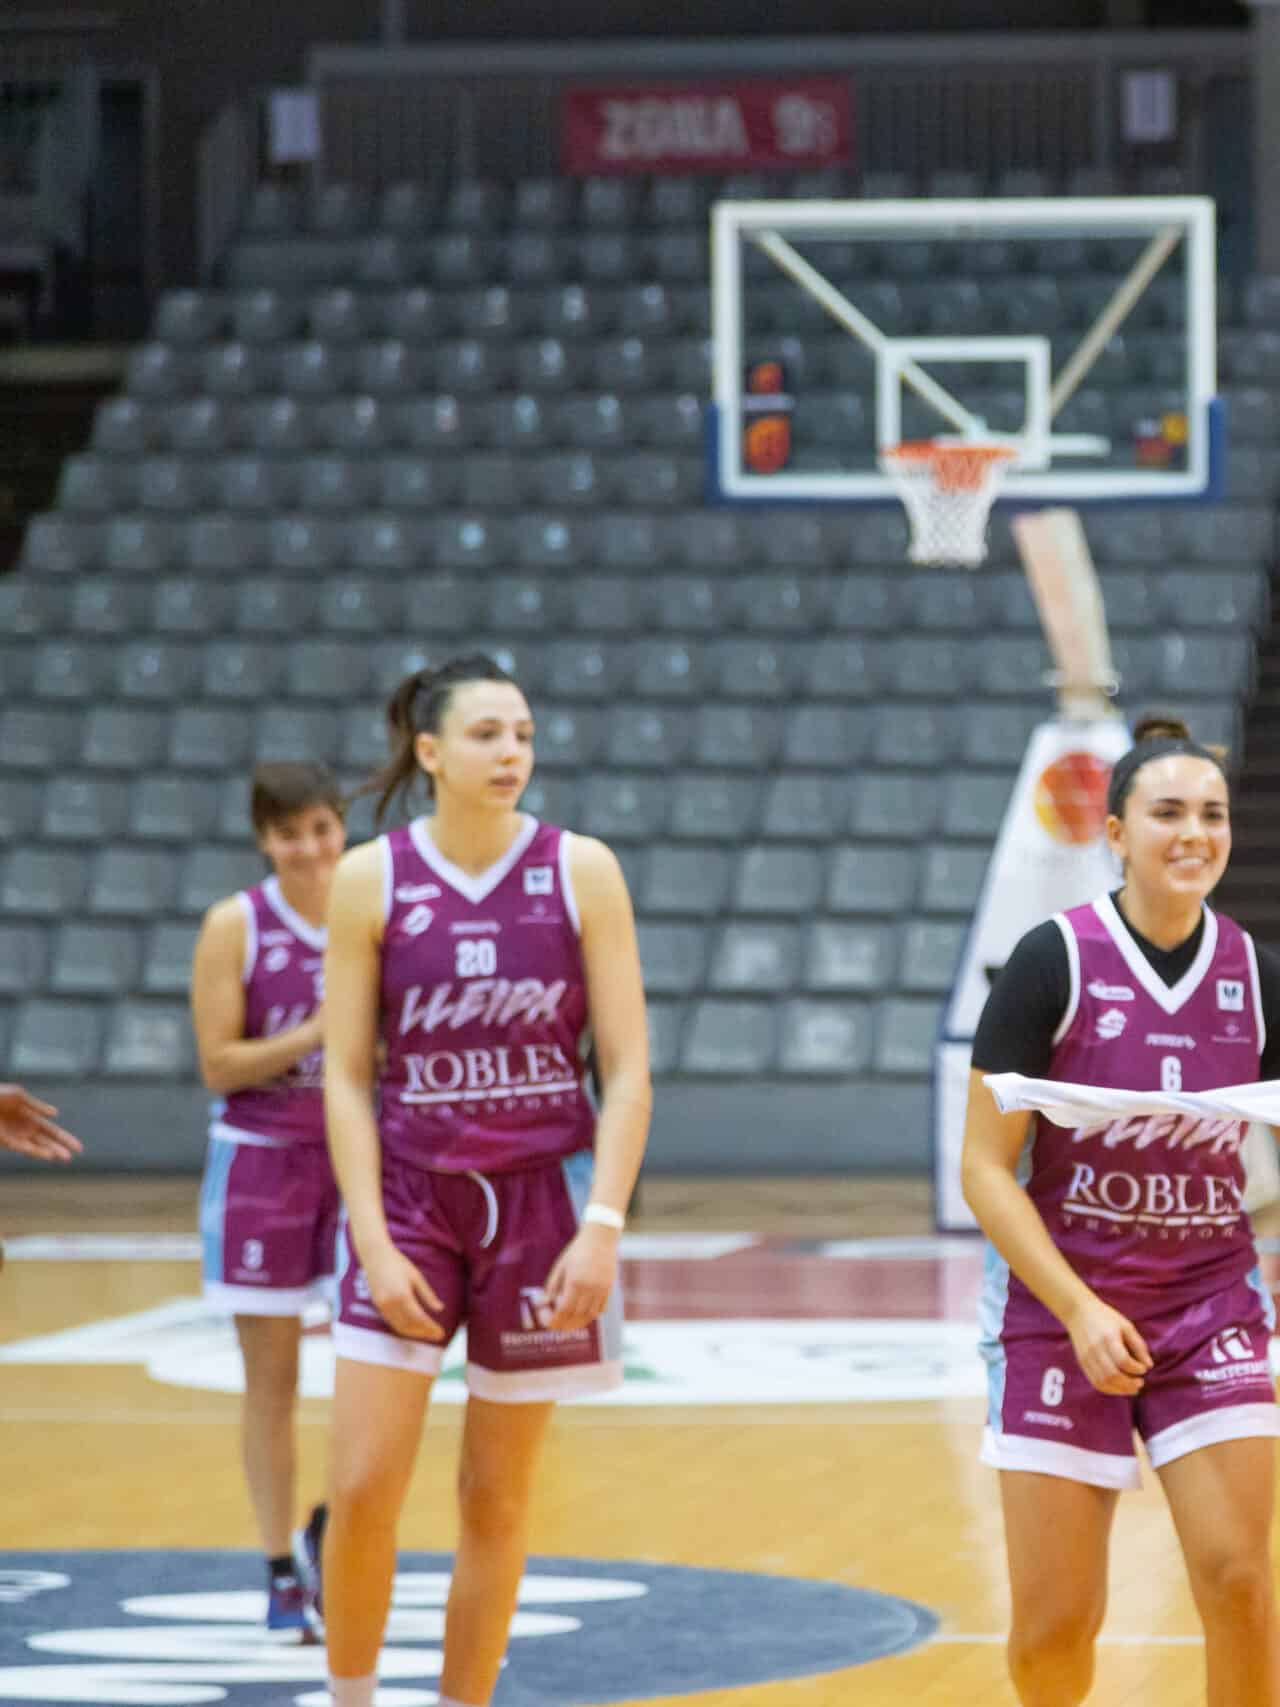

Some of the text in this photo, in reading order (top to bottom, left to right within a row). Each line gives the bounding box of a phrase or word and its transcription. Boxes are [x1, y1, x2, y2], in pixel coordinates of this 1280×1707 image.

[455, 937, 496, 977] 20
[1160, 1055, 1183, 1092] 6
[1041, 1367, 1065, 1407] 6
